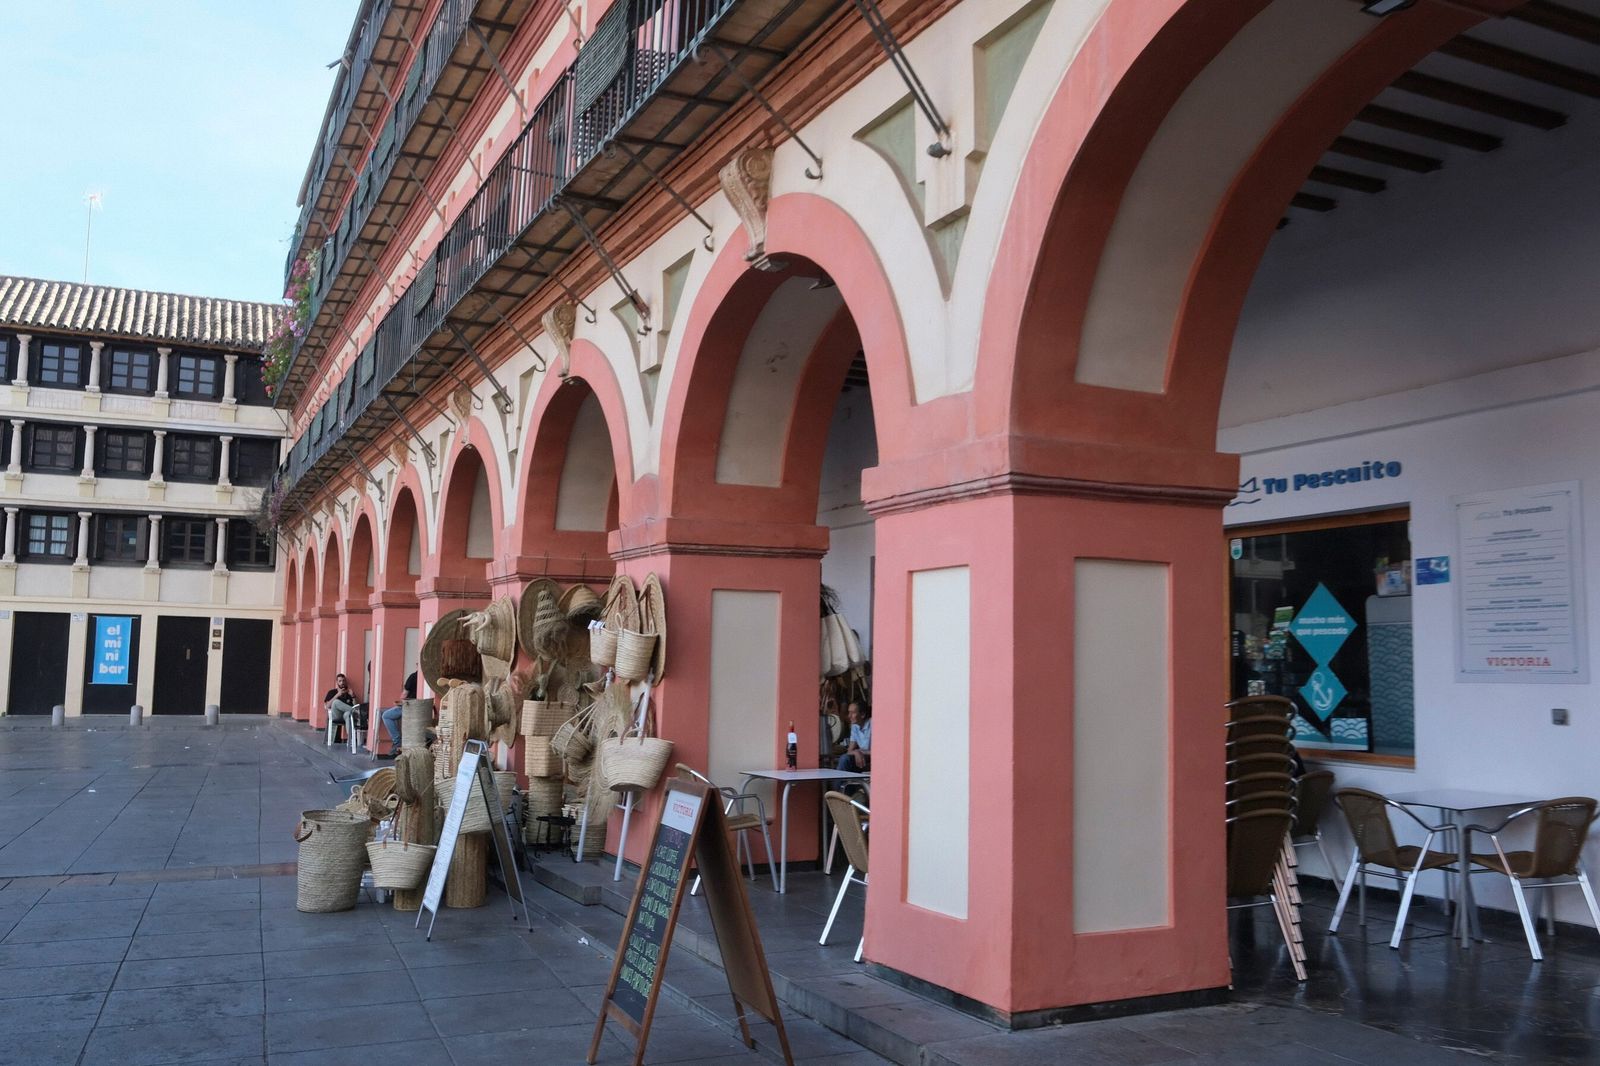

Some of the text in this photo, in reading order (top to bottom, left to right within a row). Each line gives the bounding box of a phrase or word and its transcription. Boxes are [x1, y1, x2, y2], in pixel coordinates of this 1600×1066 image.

[1262, 460, 1402, 495] Tu Pescaito
[106, 624, 121, 636] el
[104, 637, 121, 649] mi
[105, 649, 119, 661] ni
[98, 662, 125, 674] bar
[1486, 657, 1551, 667] VICTORIA
